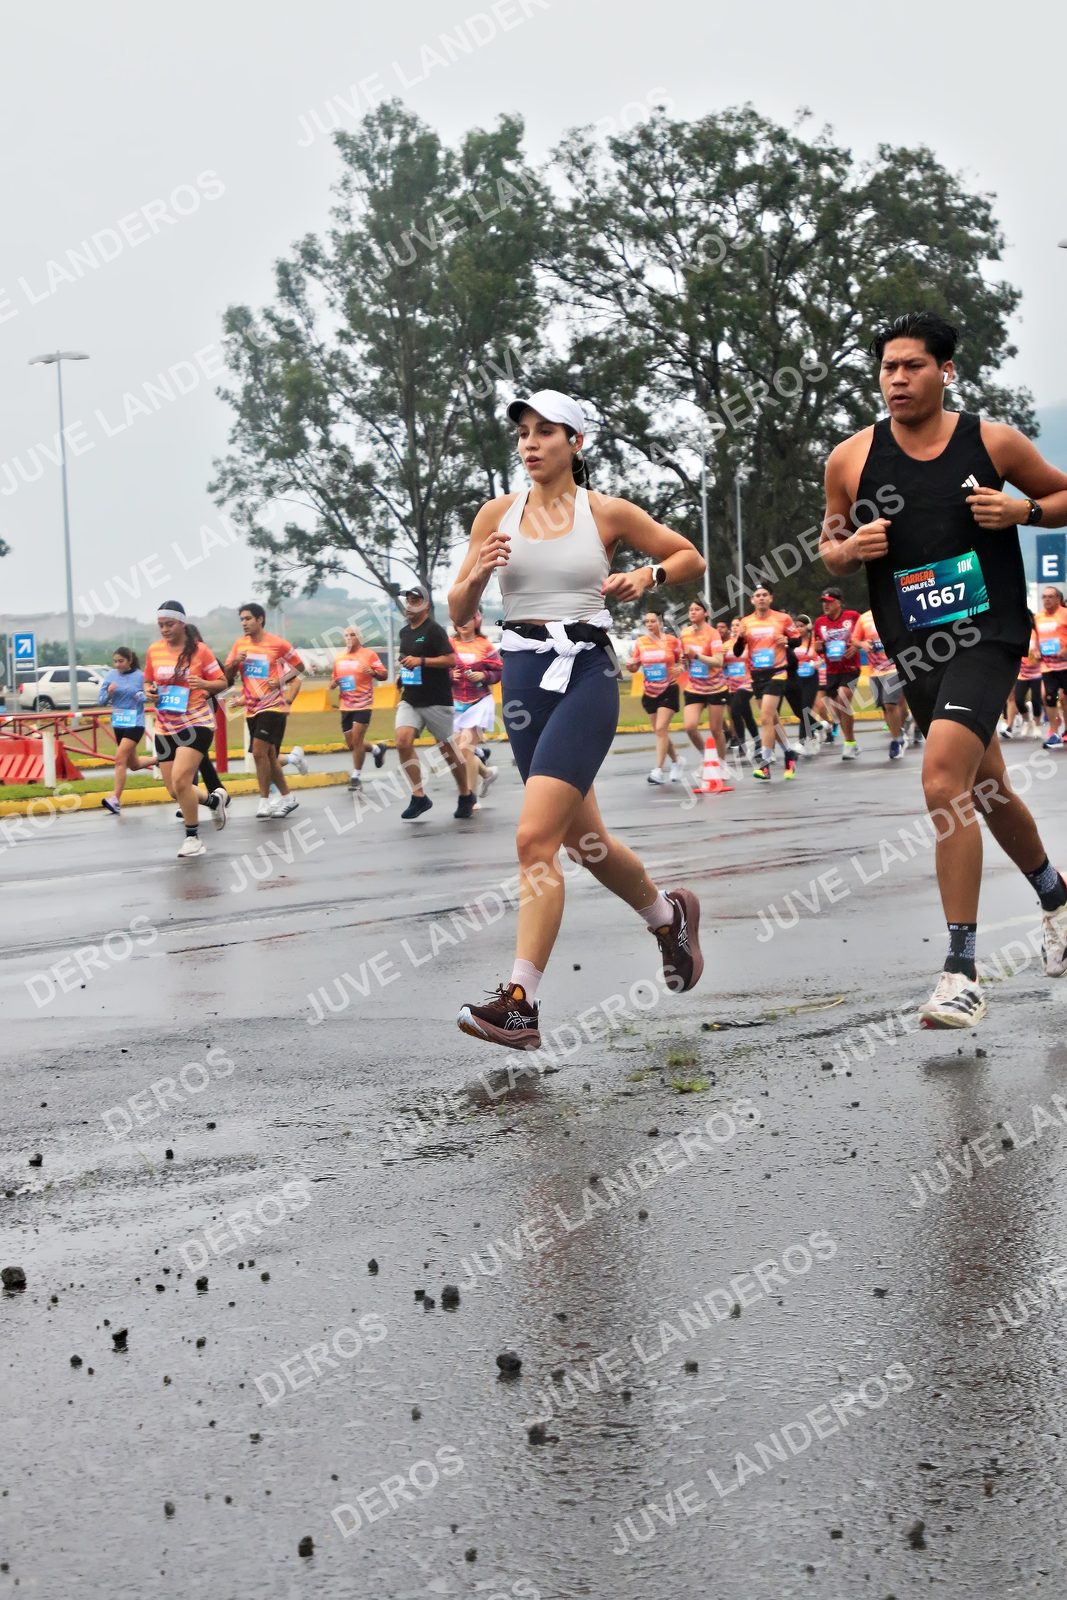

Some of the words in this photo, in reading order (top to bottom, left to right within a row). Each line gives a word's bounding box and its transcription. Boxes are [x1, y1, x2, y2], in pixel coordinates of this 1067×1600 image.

[957, 558, 973, 574] 10K
[1042, 554, 1059, 577] E
[900, 569, 934, 586] CARRERA
[901, 581, 928, 593] OMNILIFE
[916, 582, 966, 611] 1667
